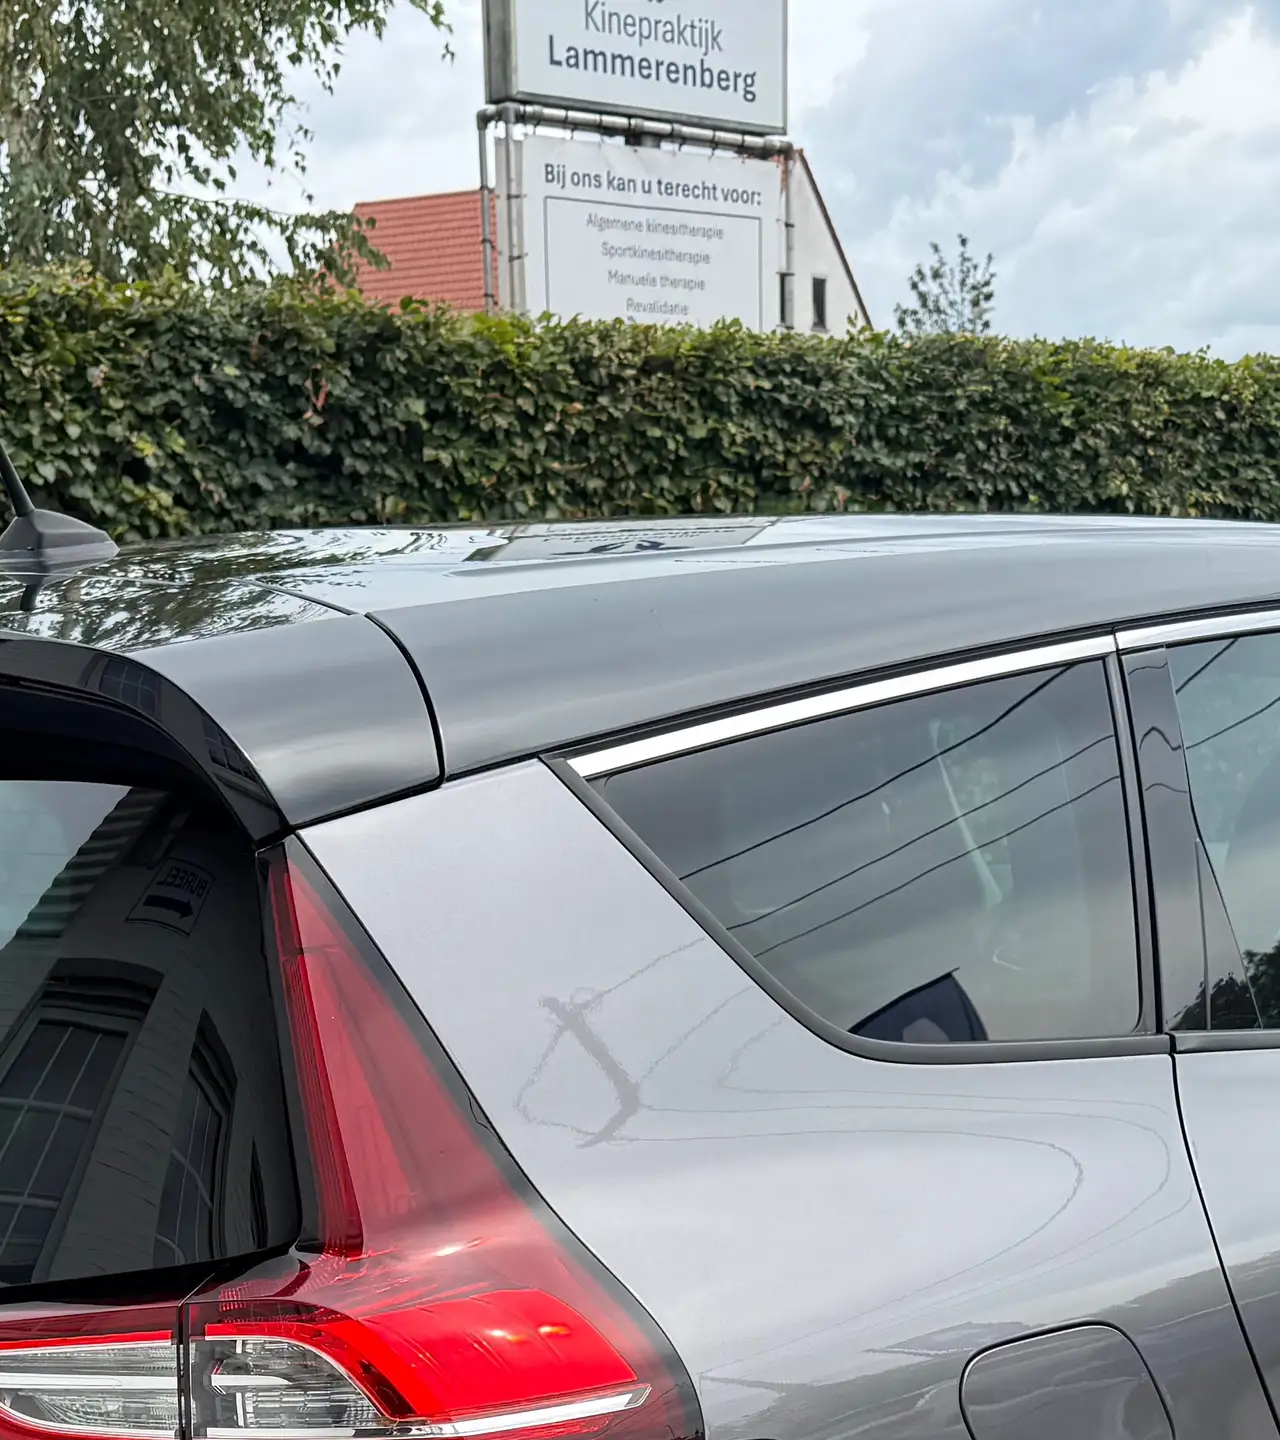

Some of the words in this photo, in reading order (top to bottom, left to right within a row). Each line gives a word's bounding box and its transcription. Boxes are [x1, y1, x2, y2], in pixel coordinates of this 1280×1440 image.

[584, 0, 723, 56] Kinepraktijk
[548, 34, 757, 102] Lammerenberg
[544, 163, 566, 190] Bij
[570, 171, 602, 189] ons
[607, 170, 636, 193] kan
[641, 179, 652, 194] u
[657, 178, 718, 201] terecht
[720, 186, 762, 206] voor:
[586, 213, 644, 233] Algemene
[646, 218, 724, 240] kinesitherapie
[600, 241, 711, 265] Sportkinesitherapie
[607, 270, 657, 288] Manuele
[659, 275, 706, 291] therapie
